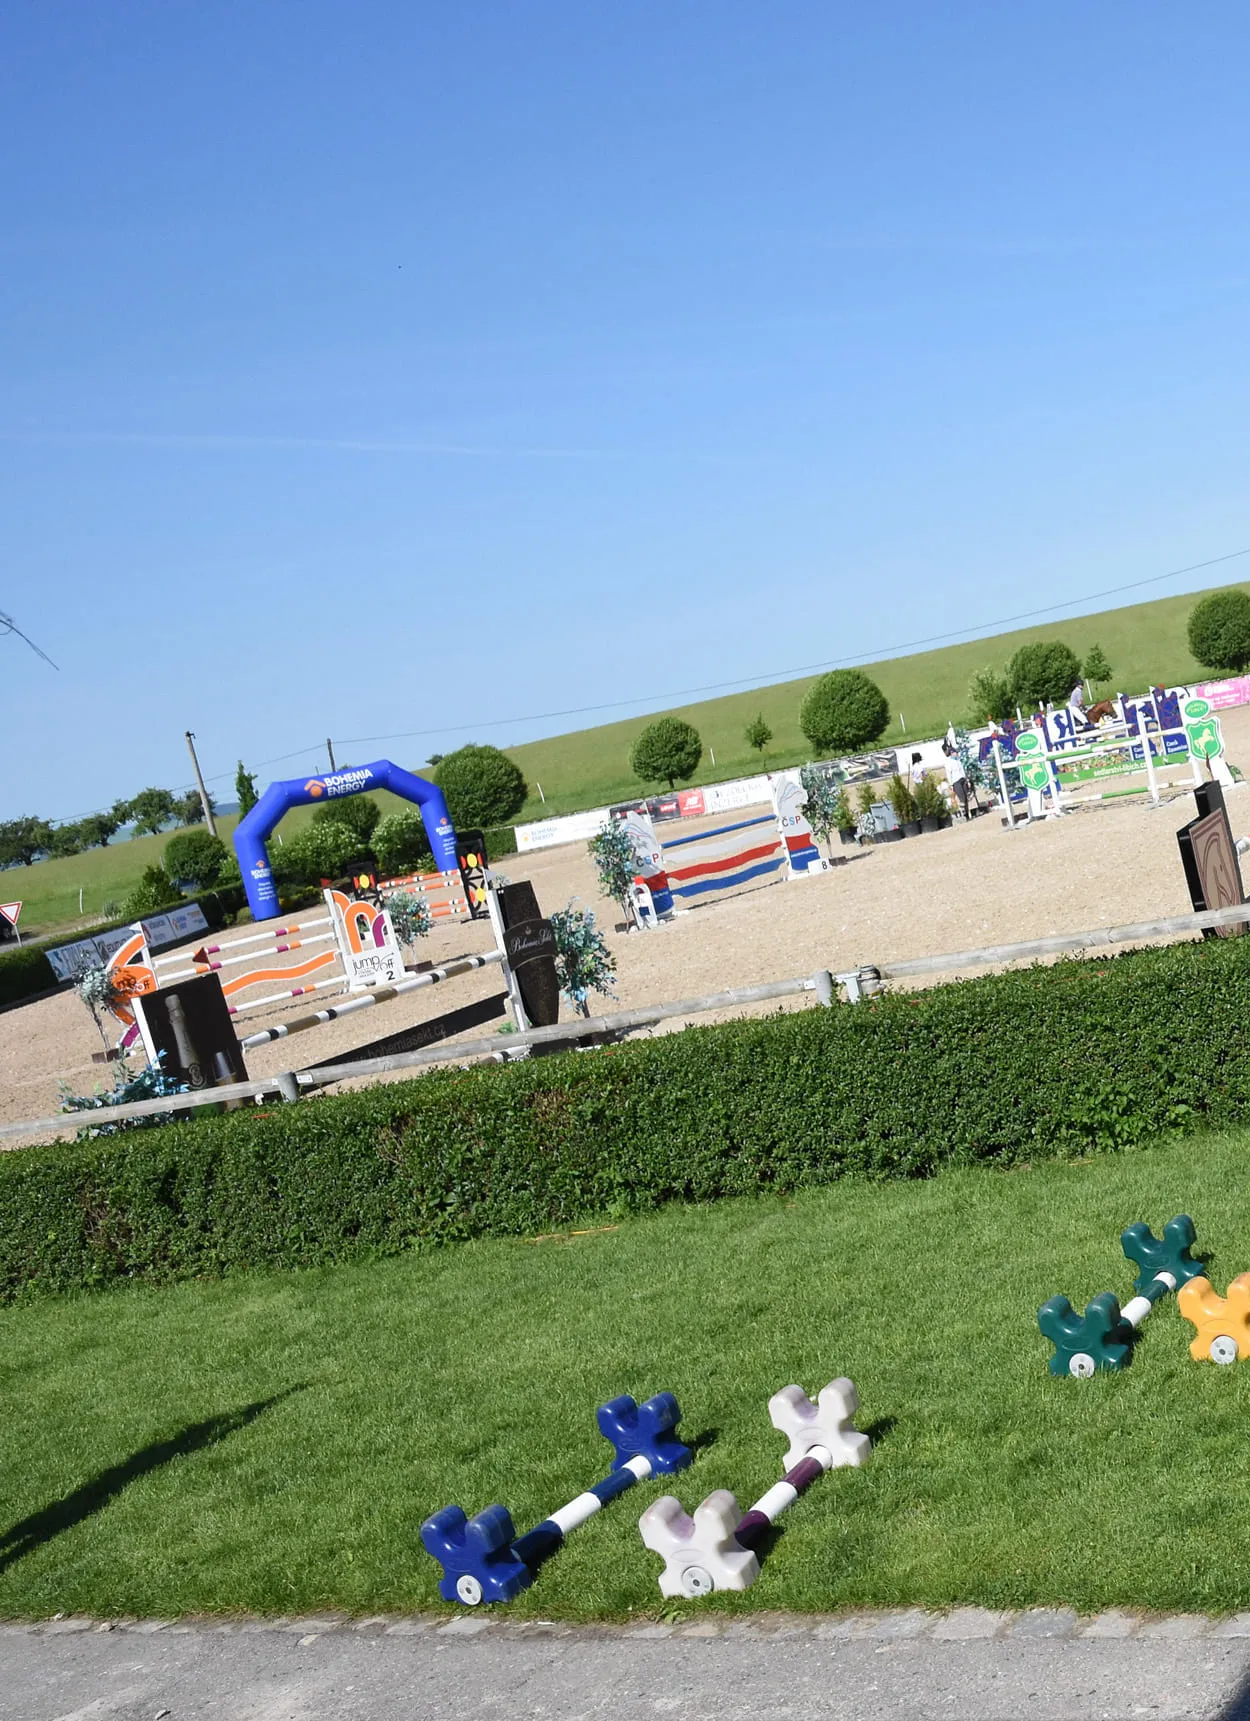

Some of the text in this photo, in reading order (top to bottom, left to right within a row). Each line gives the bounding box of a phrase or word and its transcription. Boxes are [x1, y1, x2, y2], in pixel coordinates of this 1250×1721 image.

[324, 768, 374, 787] BOHEMIA
[327, 780, 366, 797] ENERGY
[782, 815, 801, 827] ČSP
[822, 861, 828, 871] 8
[386, 970, 396, 981] 2
